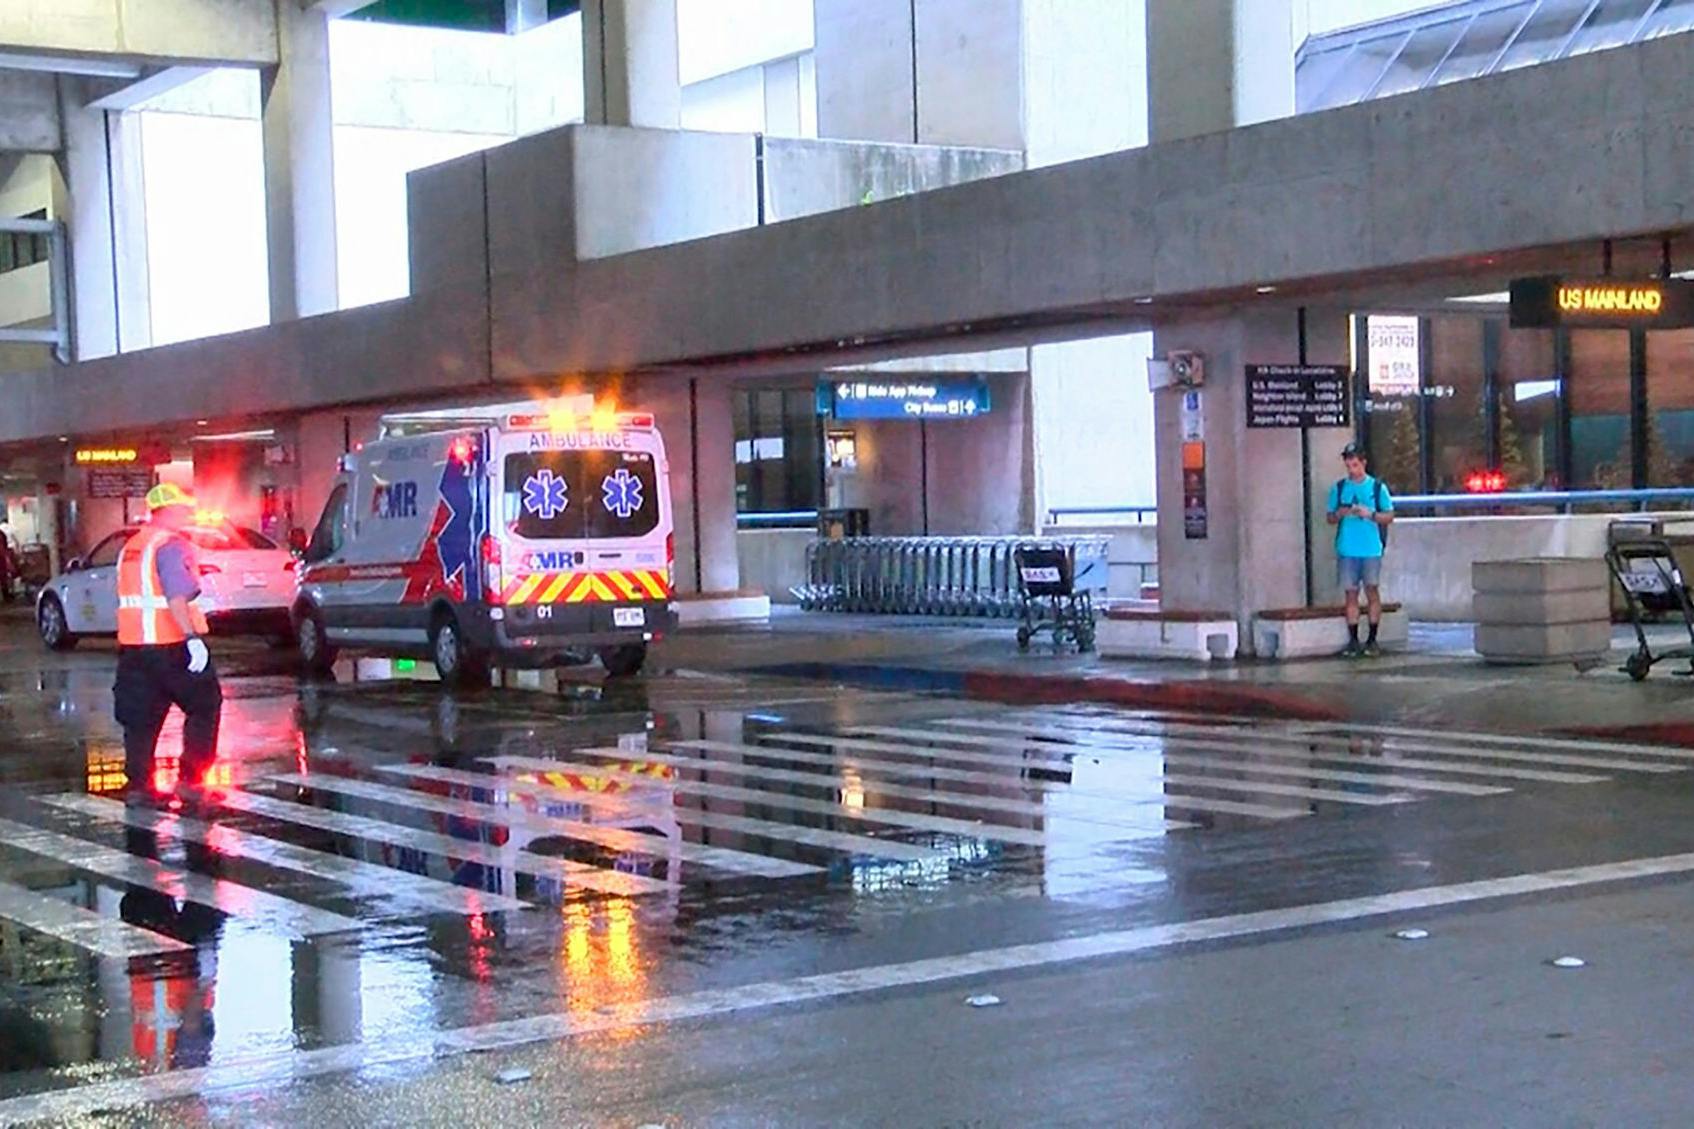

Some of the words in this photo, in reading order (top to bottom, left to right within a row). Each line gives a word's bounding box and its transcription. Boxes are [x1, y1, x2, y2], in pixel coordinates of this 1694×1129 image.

[1559, 288, 1582, 309] US
[1584, 288, 1661, 310] MAINLAND
[888, 385, 906, 399] App
[904, 402, 922, 415] City
[1315, 414, 1337, 425] Lobby
[529, 431, 633, 449] AMBULANCE
[536, 604, 553, 618] 01
